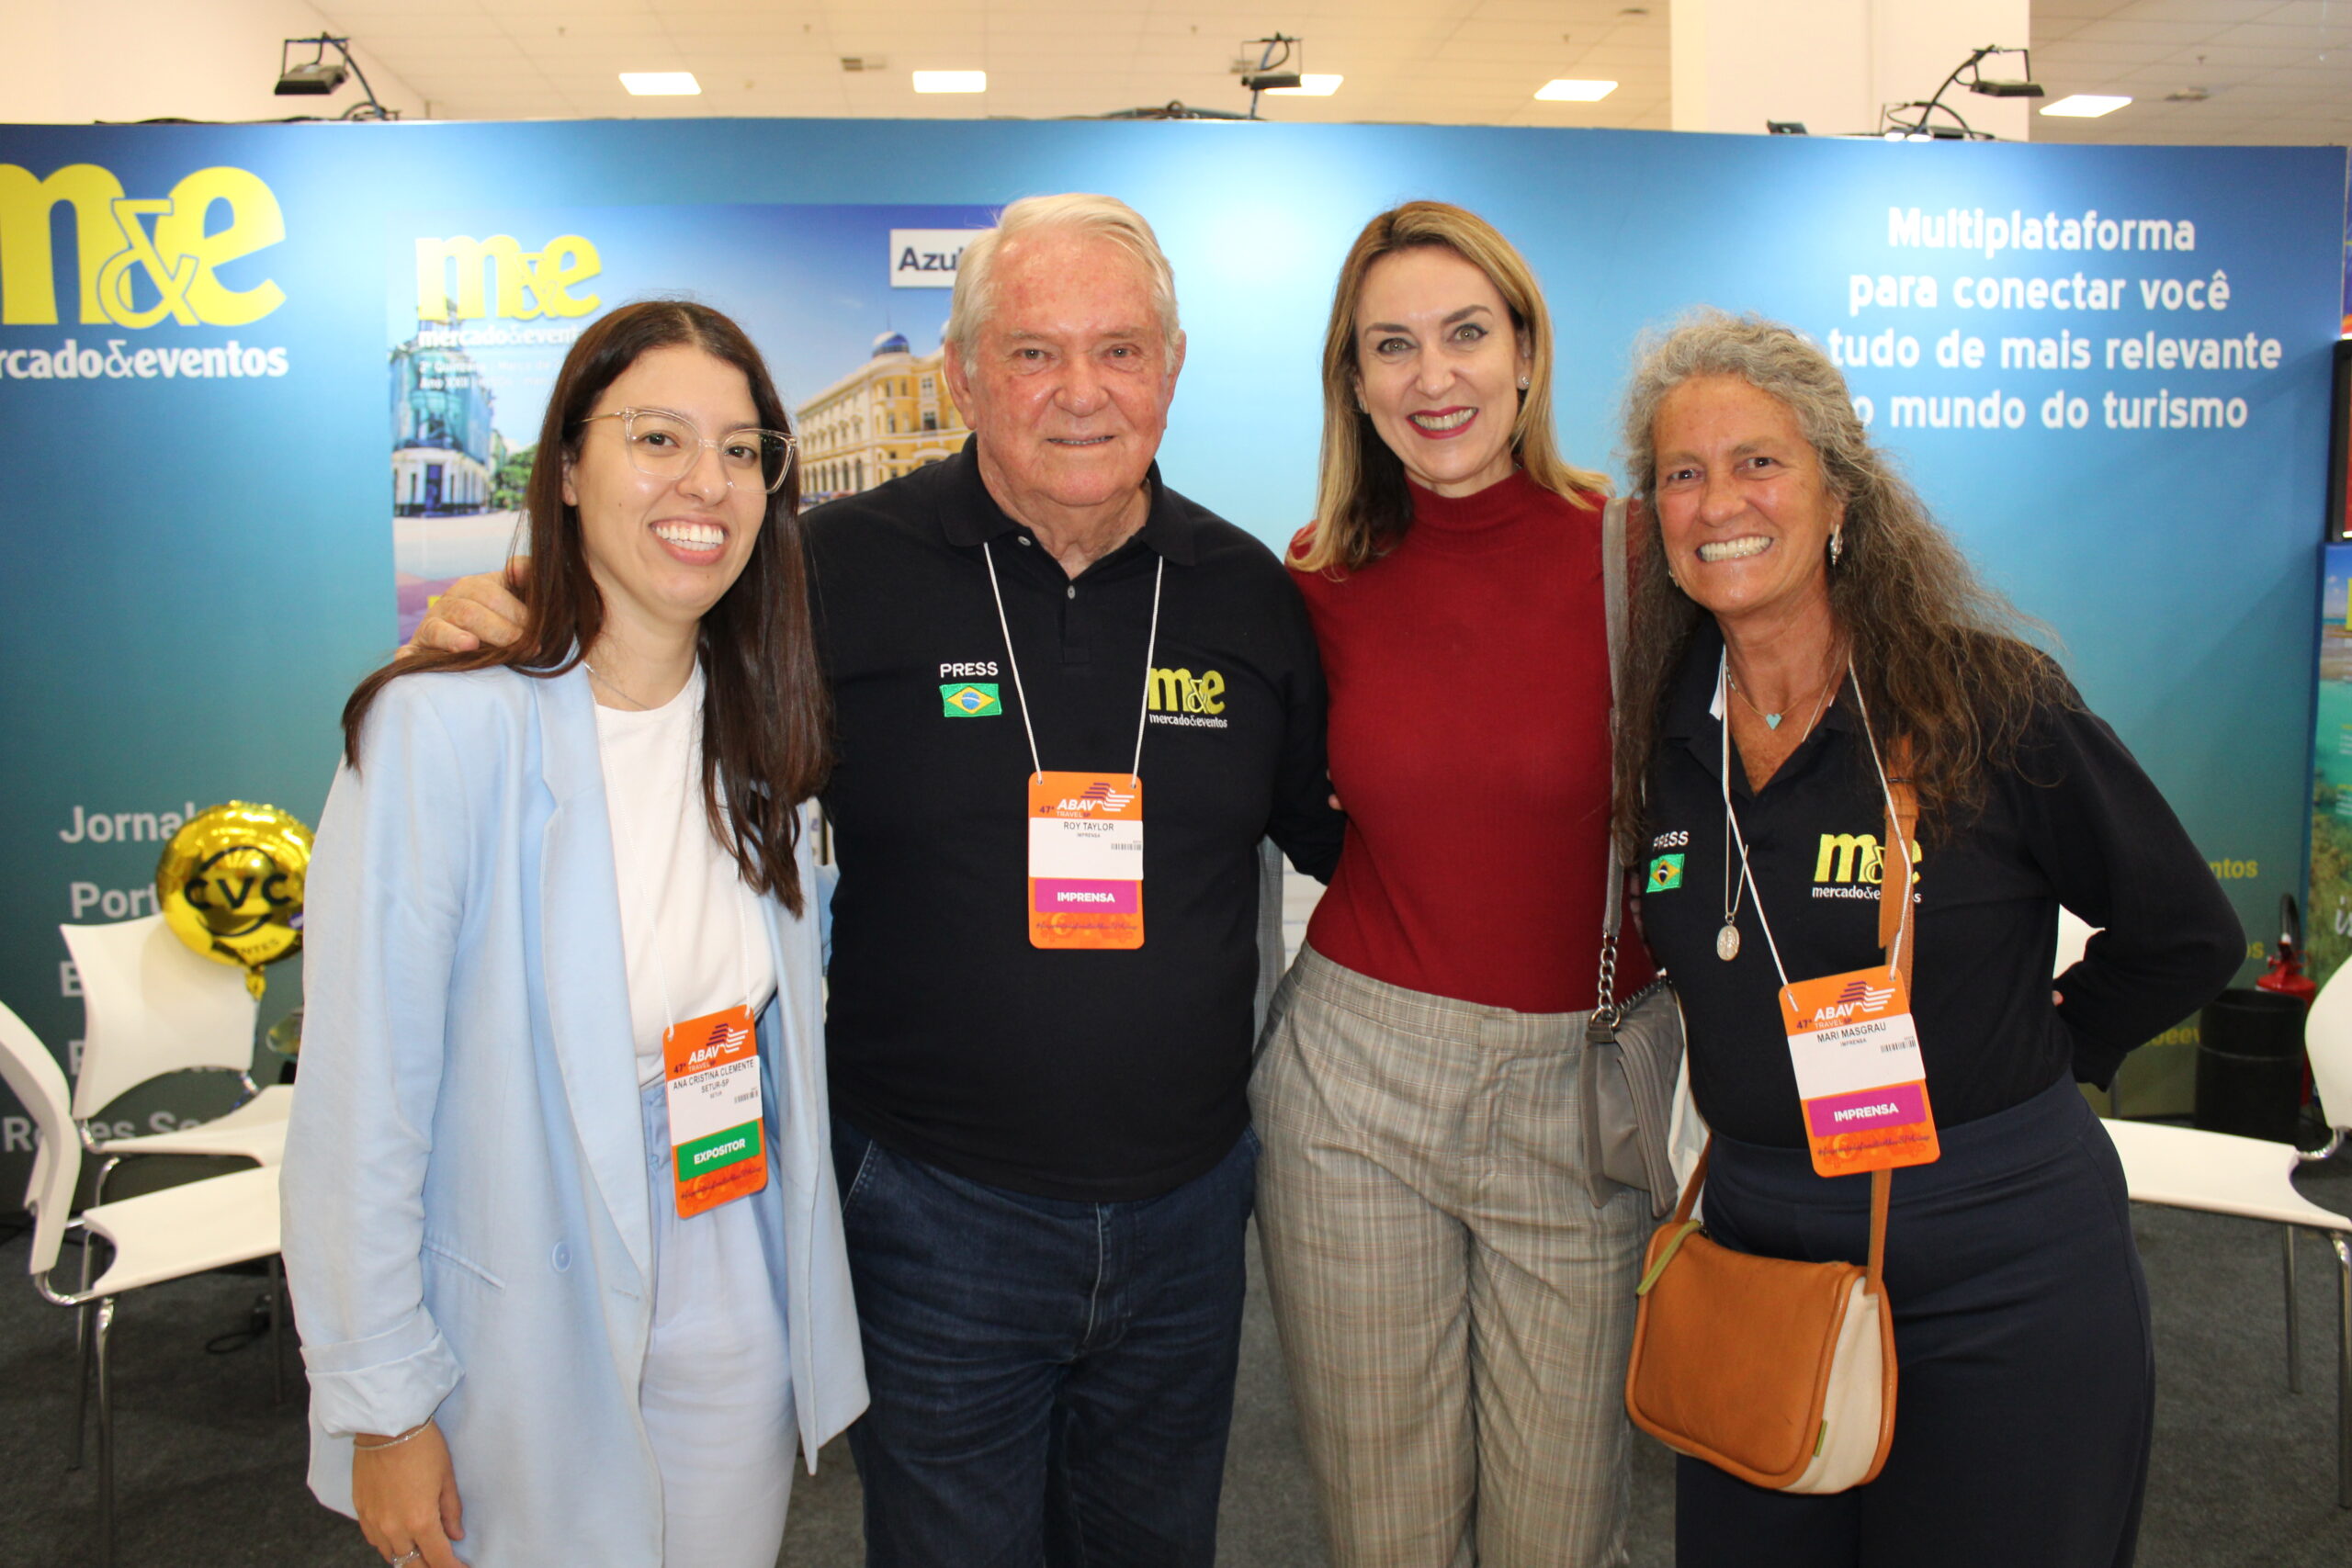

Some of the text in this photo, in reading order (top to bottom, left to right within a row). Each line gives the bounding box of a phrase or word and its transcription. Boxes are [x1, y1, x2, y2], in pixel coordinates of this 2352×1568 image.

[1888, 207, 2195, 259] Multiplataforma
[898, 246, 964, 271] Azu
[415, 234, 602, 321] m&e
[1849, 269, 2231, 317] para conectar você
[1827, 328, 2282, 370] tudo de mais relevante
[1891, 389, 2026, 429] mundo
[2041, 389, 2089, 429] do
[2103, 389, 2248, 429] turismo
[940, 661, 999, 678] PRESS
[1148, 668, 1226, 715] m&e
[1149, 714, 1227, 728] mercado&eventos
[1057, 798, 1096, 811] ABAV
[1063, 821, 1114, 831] ROY TAYLOR
[184, 872, 293, 911] CVC
[1057, 891, 1115, 904] IMPRENSA
[1814, 1002, 1855, 1022] ABAV
[1816, 1021, 1887, 1043] MARI MASGRAU
[687, 1043, 719, 1066] ABAV
[673, 1059, 754, 1090] ANA CRISTINA CLEMENTE
[701, 1078, 729, 1094] SETUR-SP
[1833, 1102, 1899, 1123] IMPRENSA
[694, 1138, 746, 1166] EXPOSITOR
